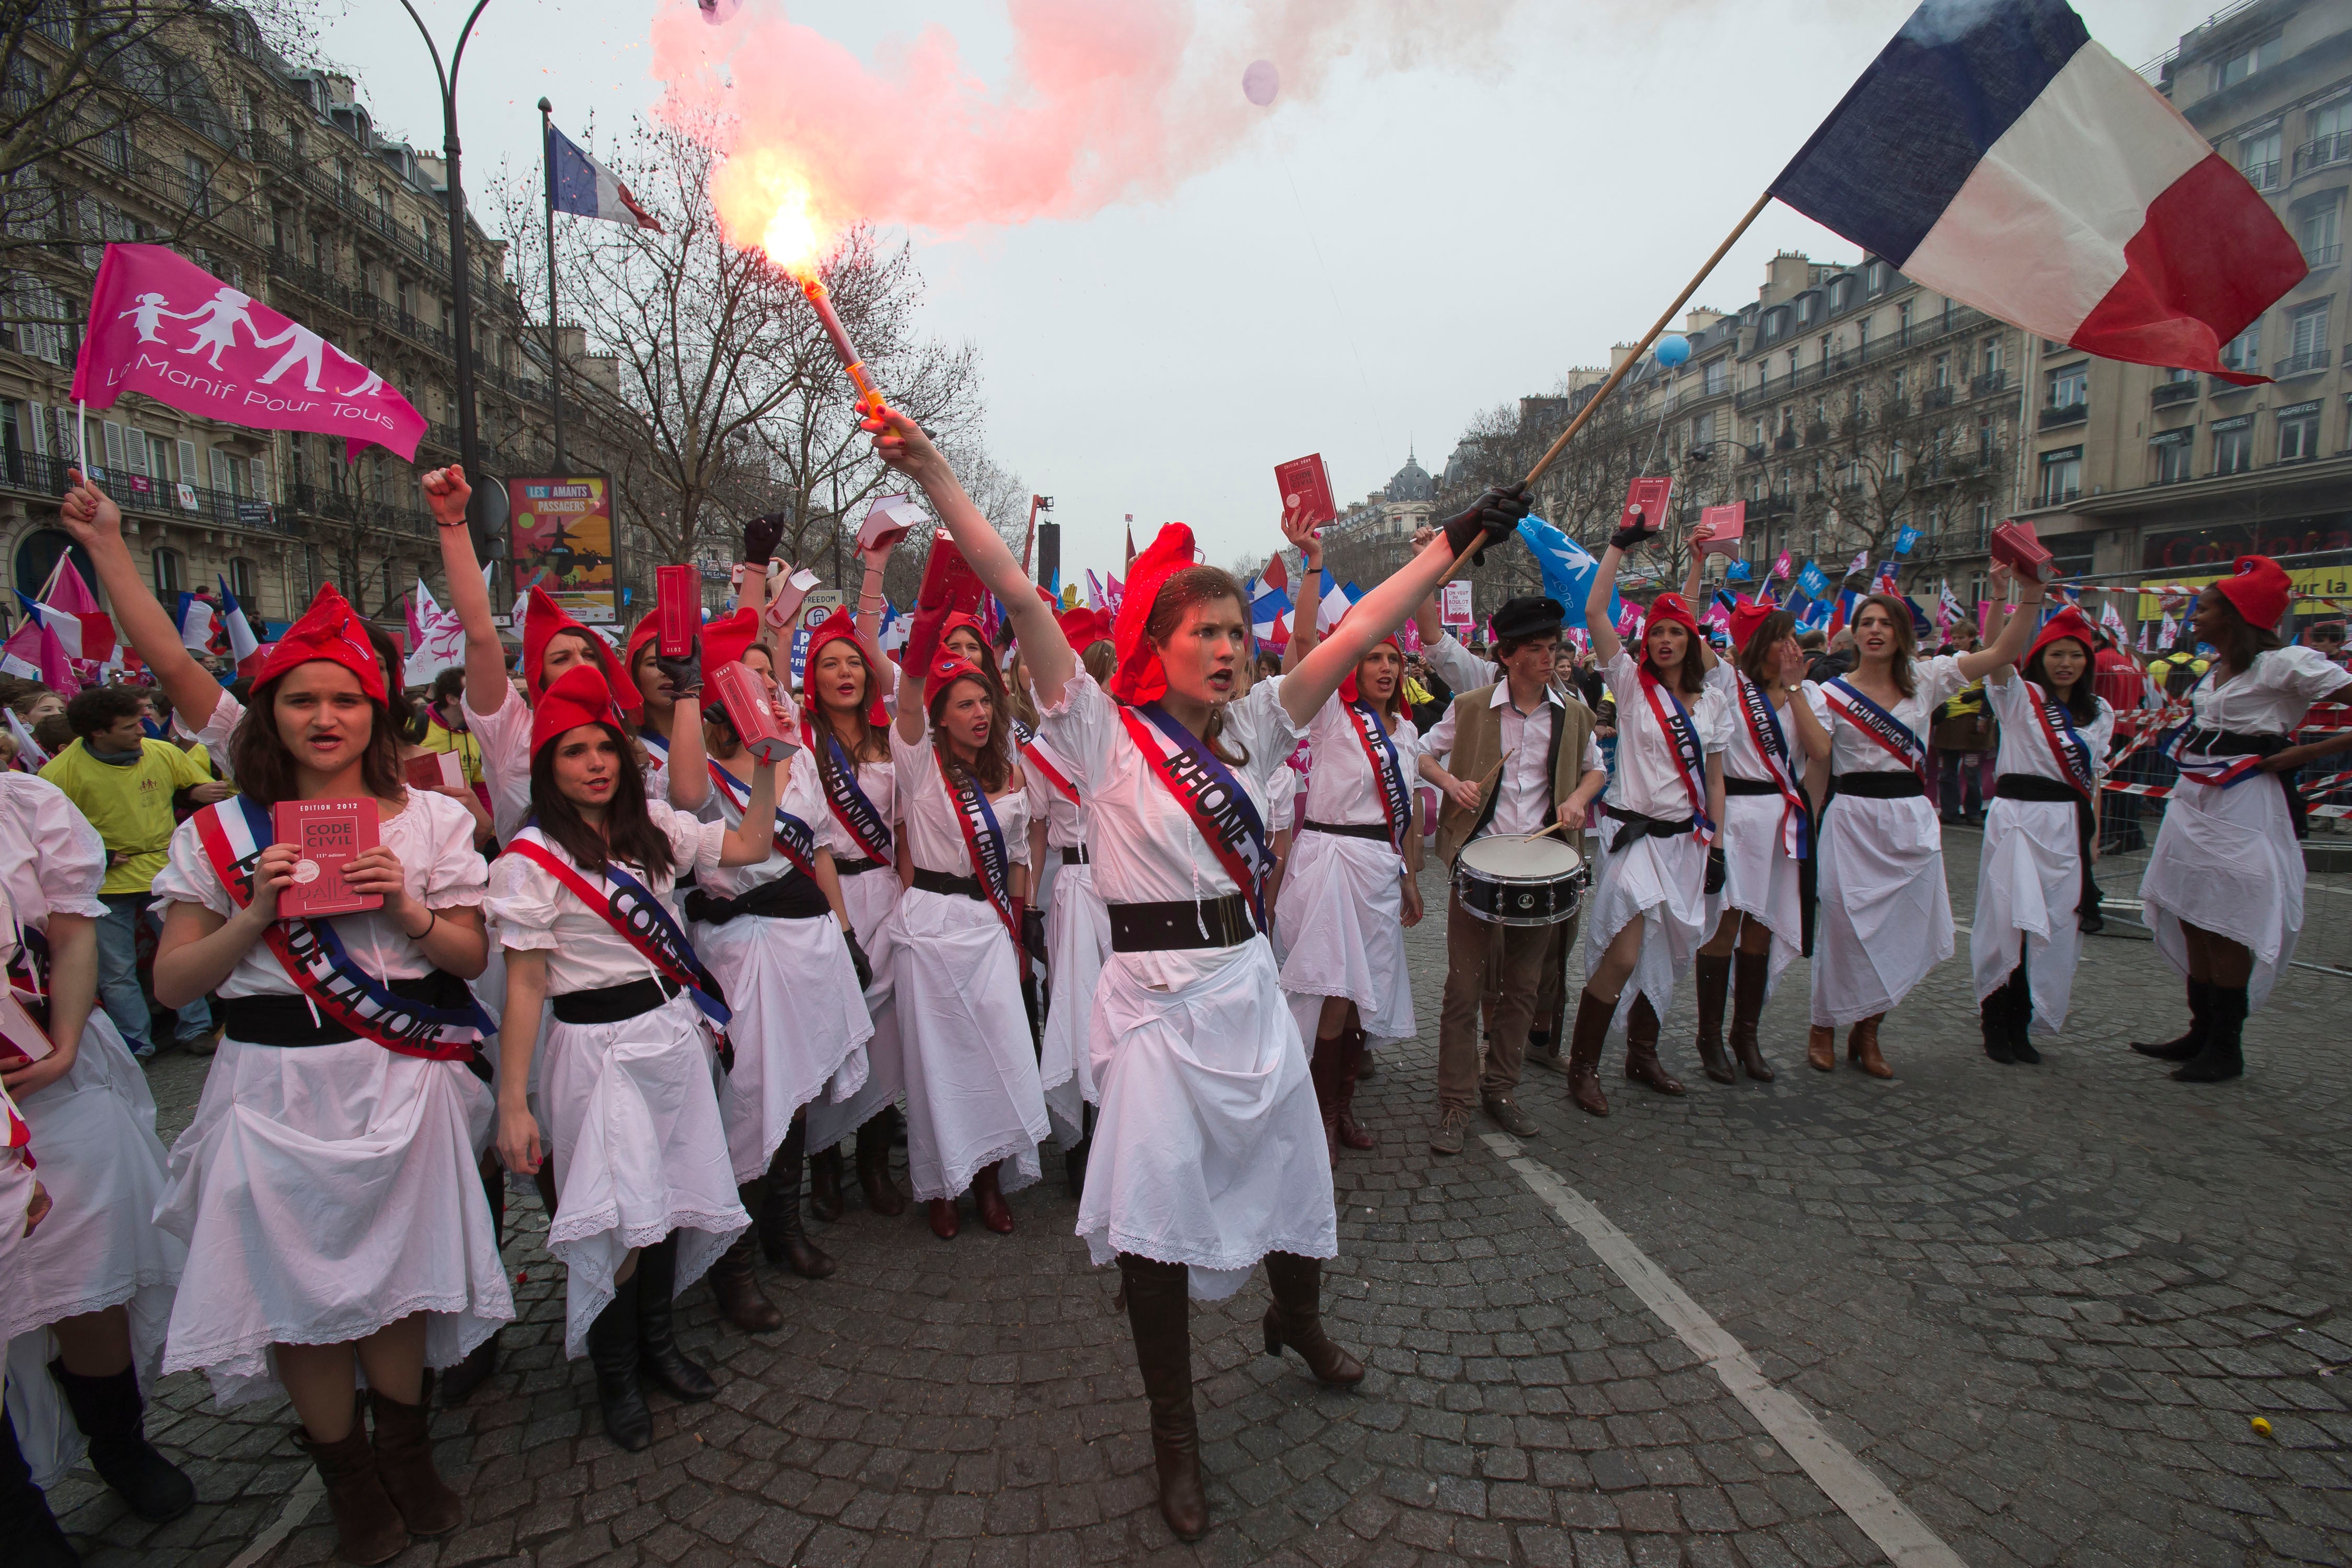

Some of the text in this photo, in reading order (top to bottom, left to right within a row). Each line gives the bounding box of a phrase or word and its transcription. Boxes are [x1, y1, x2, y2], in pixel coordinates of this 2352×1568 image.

[136, 353, 238, 400] Manif
[243, 390, 320, 412] Pour
[330, 402, 394, 430] Tous
[2277, 402, 2319, 417] AGRITEL
[2211, 418, 2247, 431] AGRITEL
[1290, 470, 1311, 481] CODE
[1292, 478, 1313, 489] CIVIL
[529, 486, 587, 498] LES AMANTS
[538, 501, 585, 512] PASSAGERS
[2326, 579, 2347, 594] la
[803, 595, 836, 604] FREEDOM
[716, 666, 730, 677] 2009
[1741, 682, 1778, 758] BOURGOGNE
[2039, 700, 2067, 733] MIDI
[1846, 698, 1914, 756] CHAMPAGNE
[1664, 713, 1698, 774] PACA
[1364, 729, 1388, 753] DE
[1378, 764, 1406, 832] FRANCE
[306, 823, 352, 835] CODE
[307, 836, 352, 847] CIVIL
[608, 886, 692, 978] CORSE
[315, 966, 371, 1017] LA
[363, 1004, 444, 1052] LOIRE
